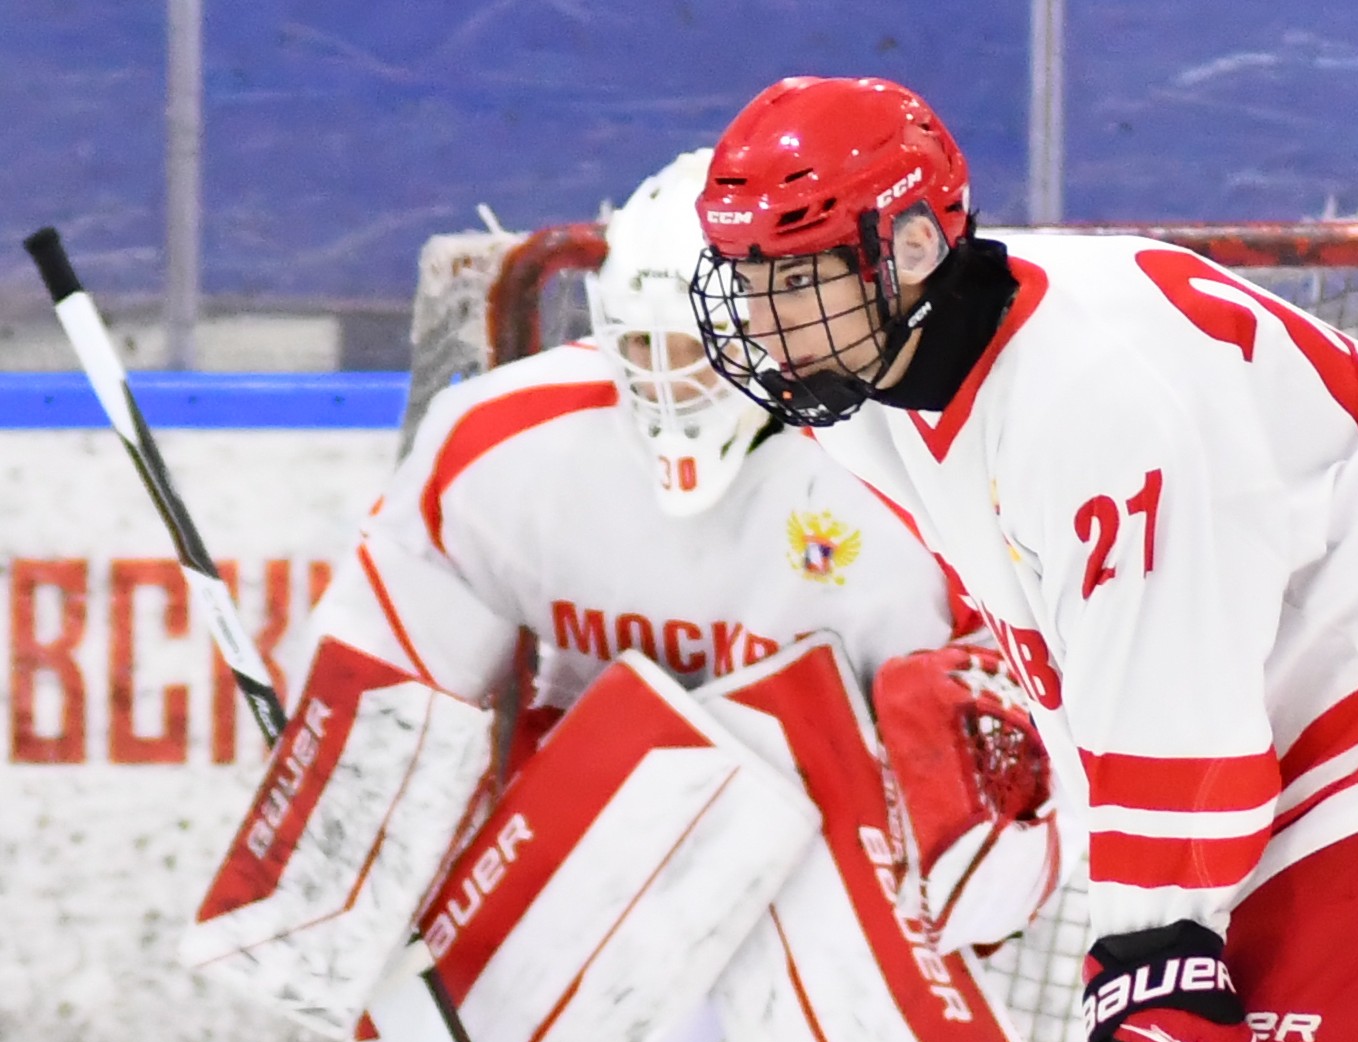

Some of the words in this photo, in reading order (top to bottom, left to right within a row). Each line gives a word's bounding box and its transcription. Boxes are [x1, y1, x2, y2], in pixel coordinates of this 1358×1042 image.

[876, 166, 922, 209] CCM
[707, 210, 753, 225] CCM
[907, 302, 932, 328] CCM
[657, 455, 697, 492] 30
[1073, 469, 1163, 601] 21
[10, 557, 334, 766] ВСК
[423, 812, 534, 960] AUER
